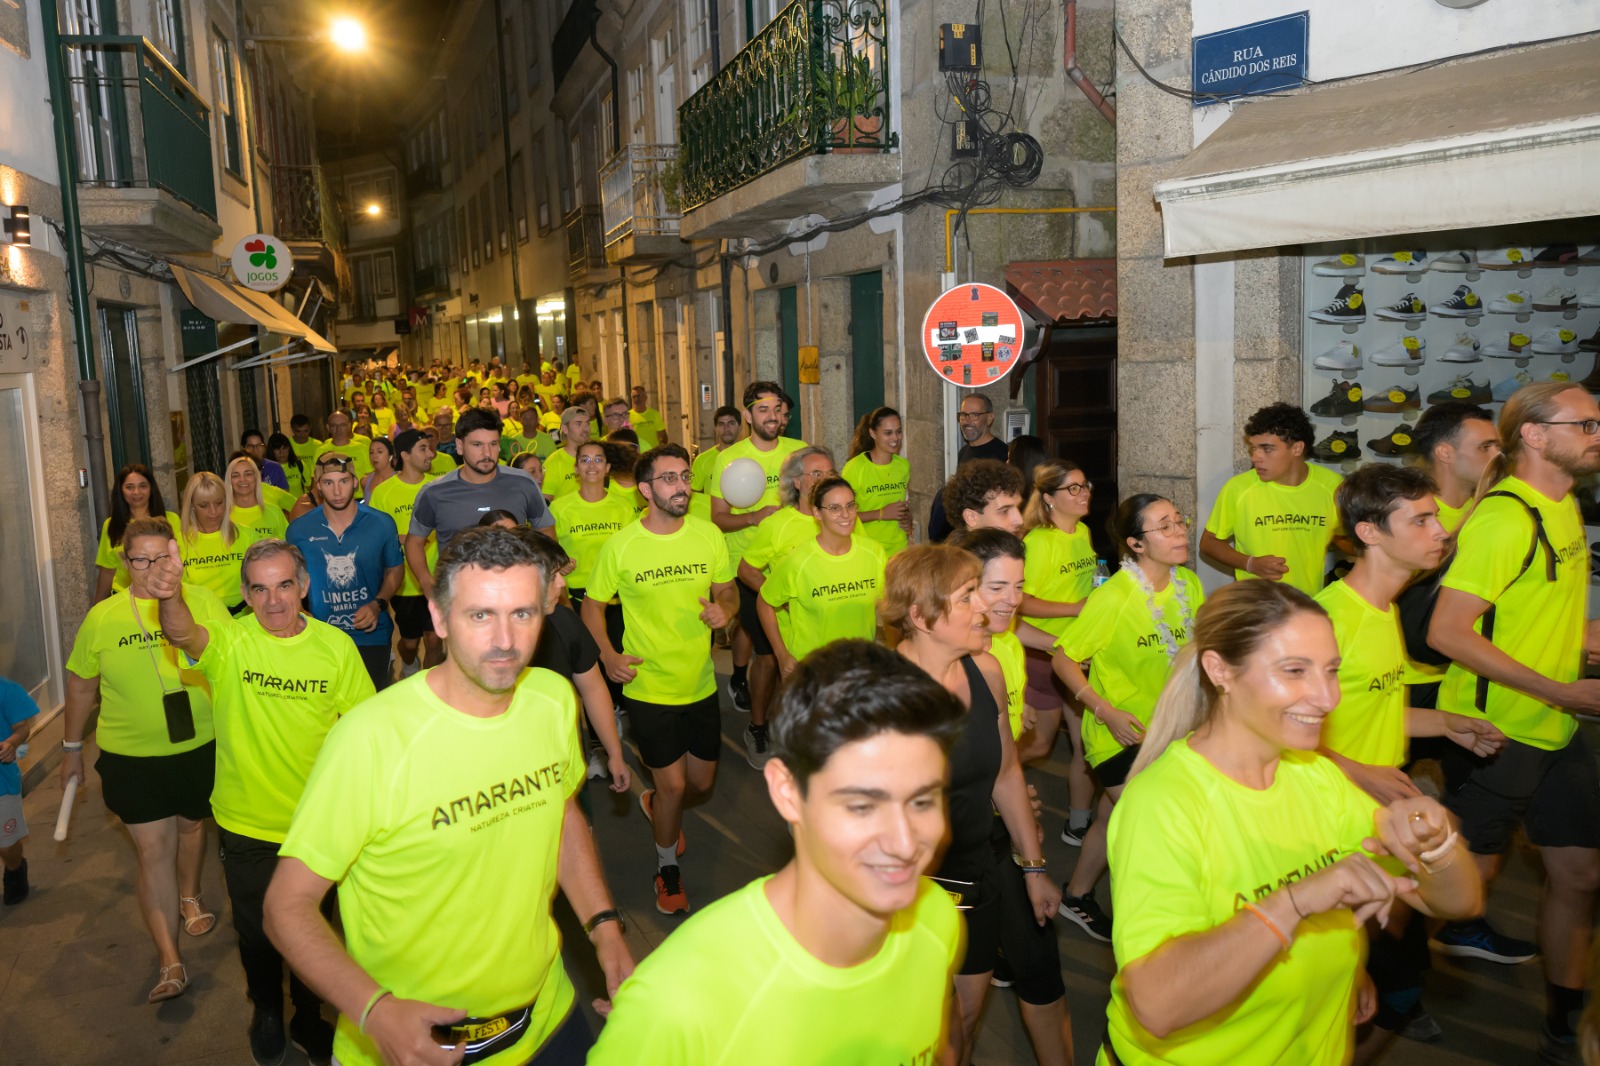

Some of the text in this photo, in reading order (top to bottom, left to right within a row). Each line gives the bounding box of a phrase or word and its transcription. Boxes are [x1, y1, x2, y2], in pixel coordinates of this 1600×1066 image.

[1233, 46, 1263, 62] RUA
[1201, 53, 1297, 84] CÂNDIDO DOS REIS
[247, 272, 279, 284] JOGOS
[866, 482, 907, 494] AMARANTE
[570, 522, 622, 534] AMARANTE
[1255, 514, 1326, 527] AMARANTE
[183, 552, 243, 568] AMARANTE
[635, 563, 708, 584] AMARANTE
[321, 586, 369, 604] LINCES
[812, 578, 875, 598] AMARANTE
[242, 669, 329, 694] AMARANTE
[431, 761, 562, 831] AMARANTE
[470, 798, 548, 834] NATUREZA CRIATIVA
[475, 1018, 505, 1040] FEST!
